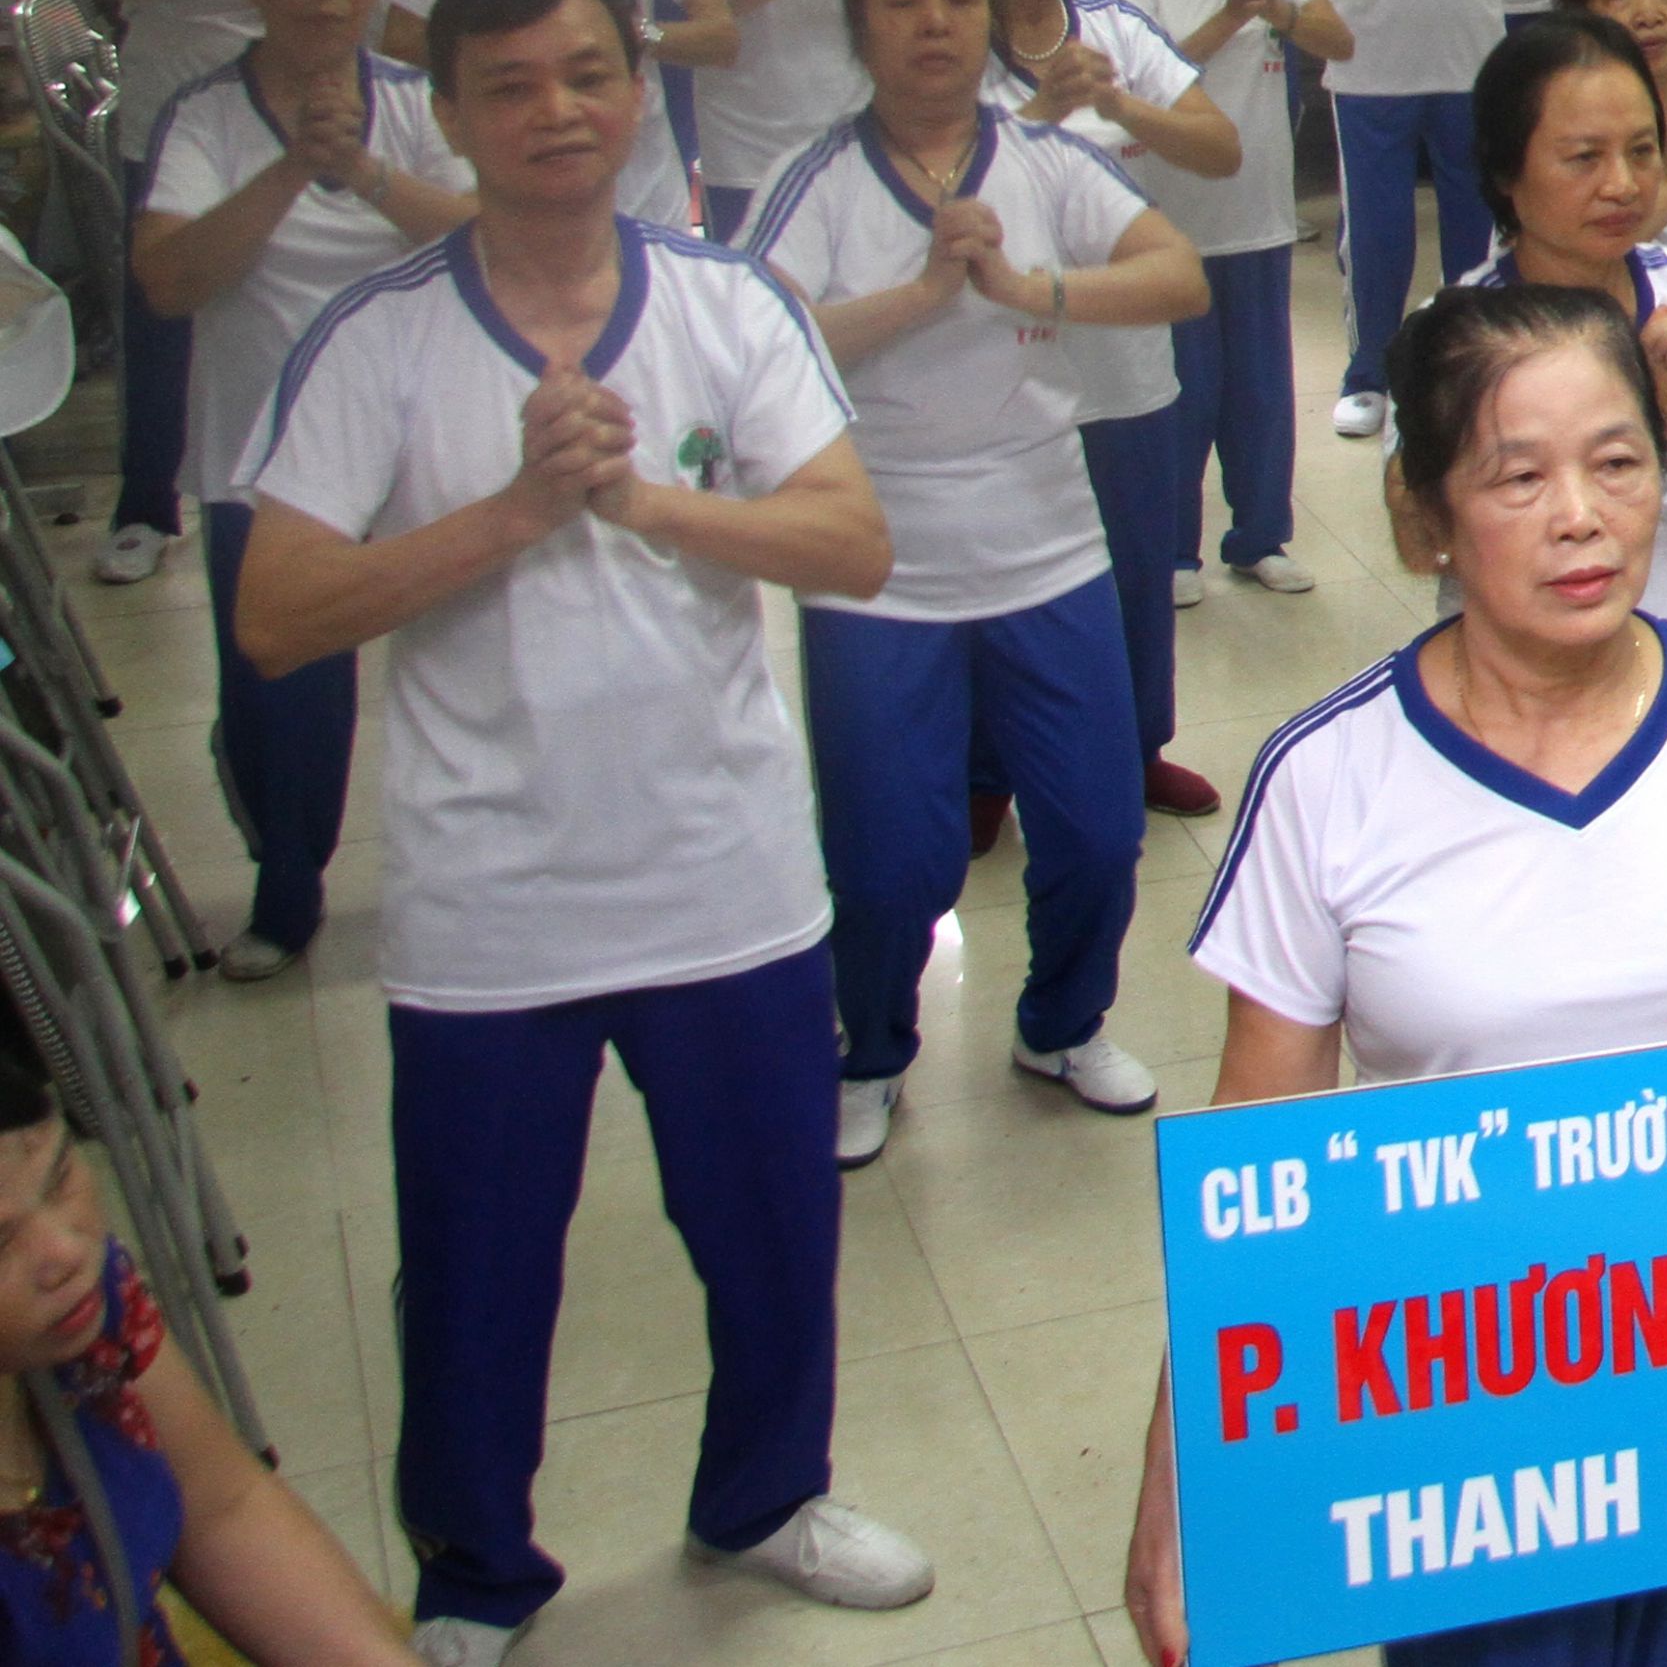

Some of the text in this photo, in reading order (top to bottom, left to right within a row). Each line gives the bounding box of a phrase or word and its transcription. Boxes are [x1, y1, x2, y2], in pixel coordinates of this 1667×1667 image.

[1200, 1159, 1311, 1241] CLB
[1216, 1322, 1299, 1444] P.
[1329, 1448, 1641, 1587] THANH
